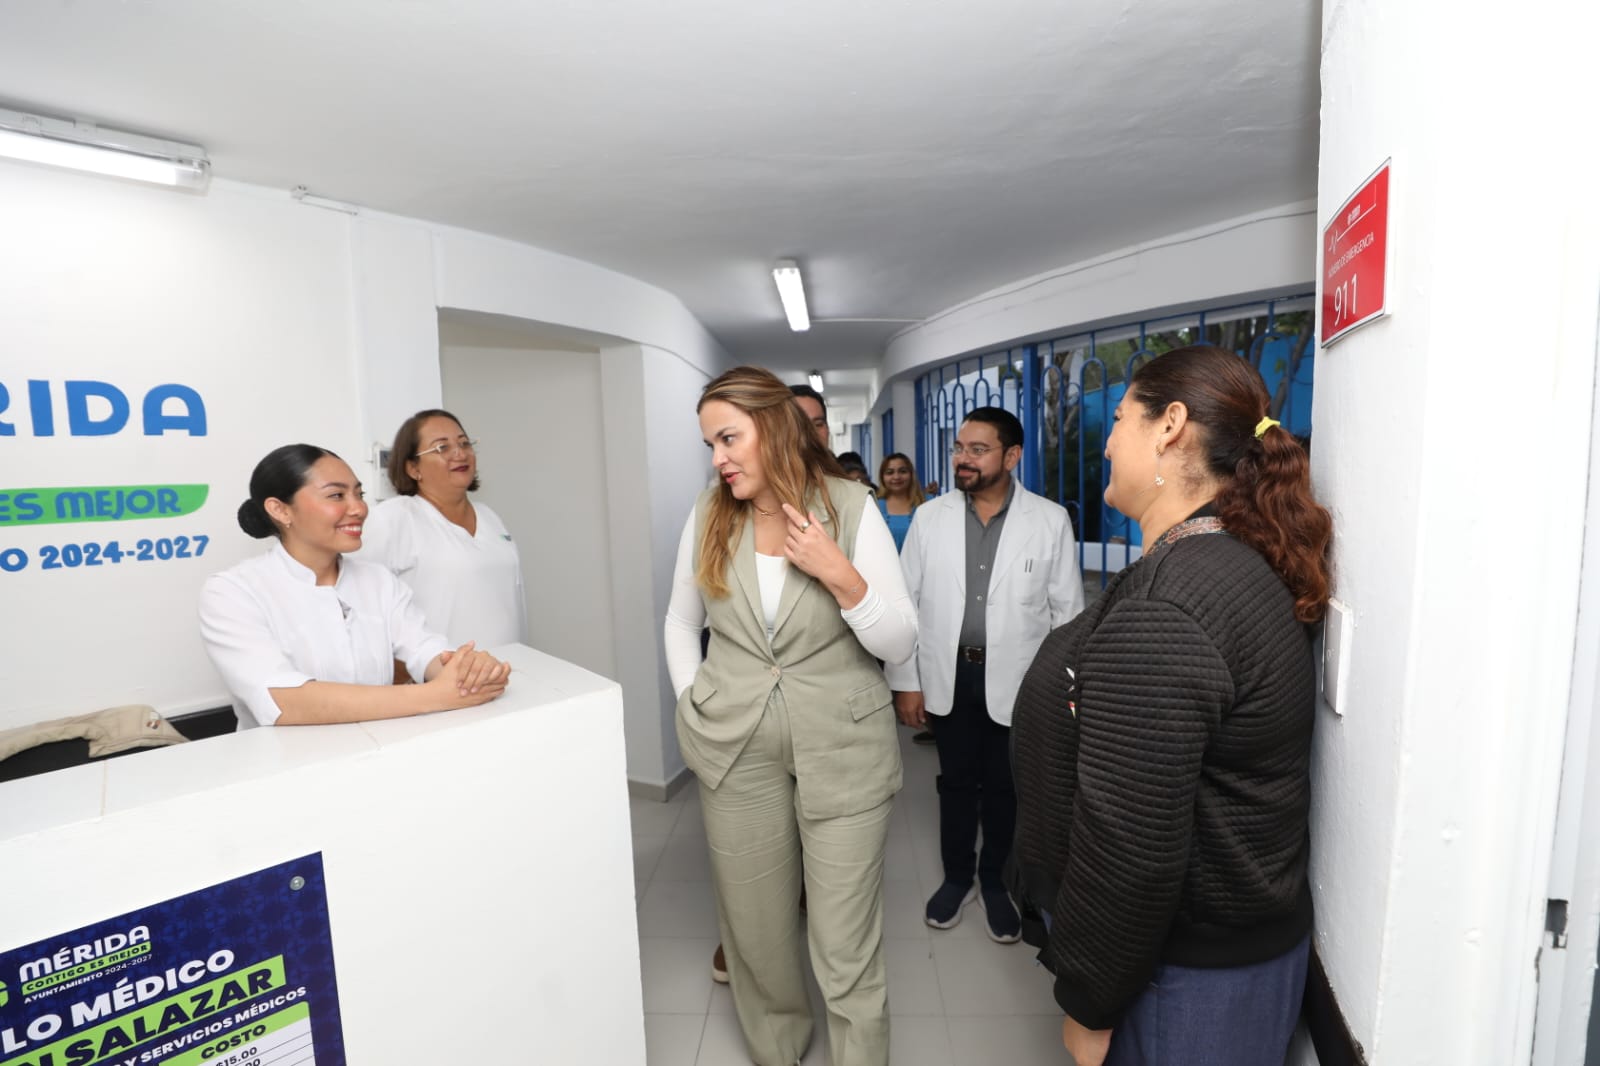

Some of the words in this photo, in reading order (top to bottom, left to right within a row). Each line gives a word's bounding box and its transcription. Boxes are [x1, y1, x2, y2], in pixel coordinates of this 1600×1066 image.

[1334, 273, 1358, 326] 911
[0, 379, 208, 437] IDA
[54, 488, 181, 520] MEJOR
[39, 534, 210, 570] 2024-2027
[19, 925, 150, 983] MÉRIDA
[24, 971, 103, 1004] AYUNTAMIENTO
[104, 954, 153, 976] 2024-2027
[26, 966, 86, 991] CONTIGO
[90, 959, 105, 970] ES
[108, 944, 149, 963] MEJOR
[1, 1013, 63, 1054] LO
[70, 949, 235, 1028] MÉDICO
[64, 968, 274, 1066] SALAZAR
[140, 1016, 234, 1063] SERVICIOS
[235, 986, 307, 1026] MÉDICOS
[201, 1024, 267, 1060] COSTO
